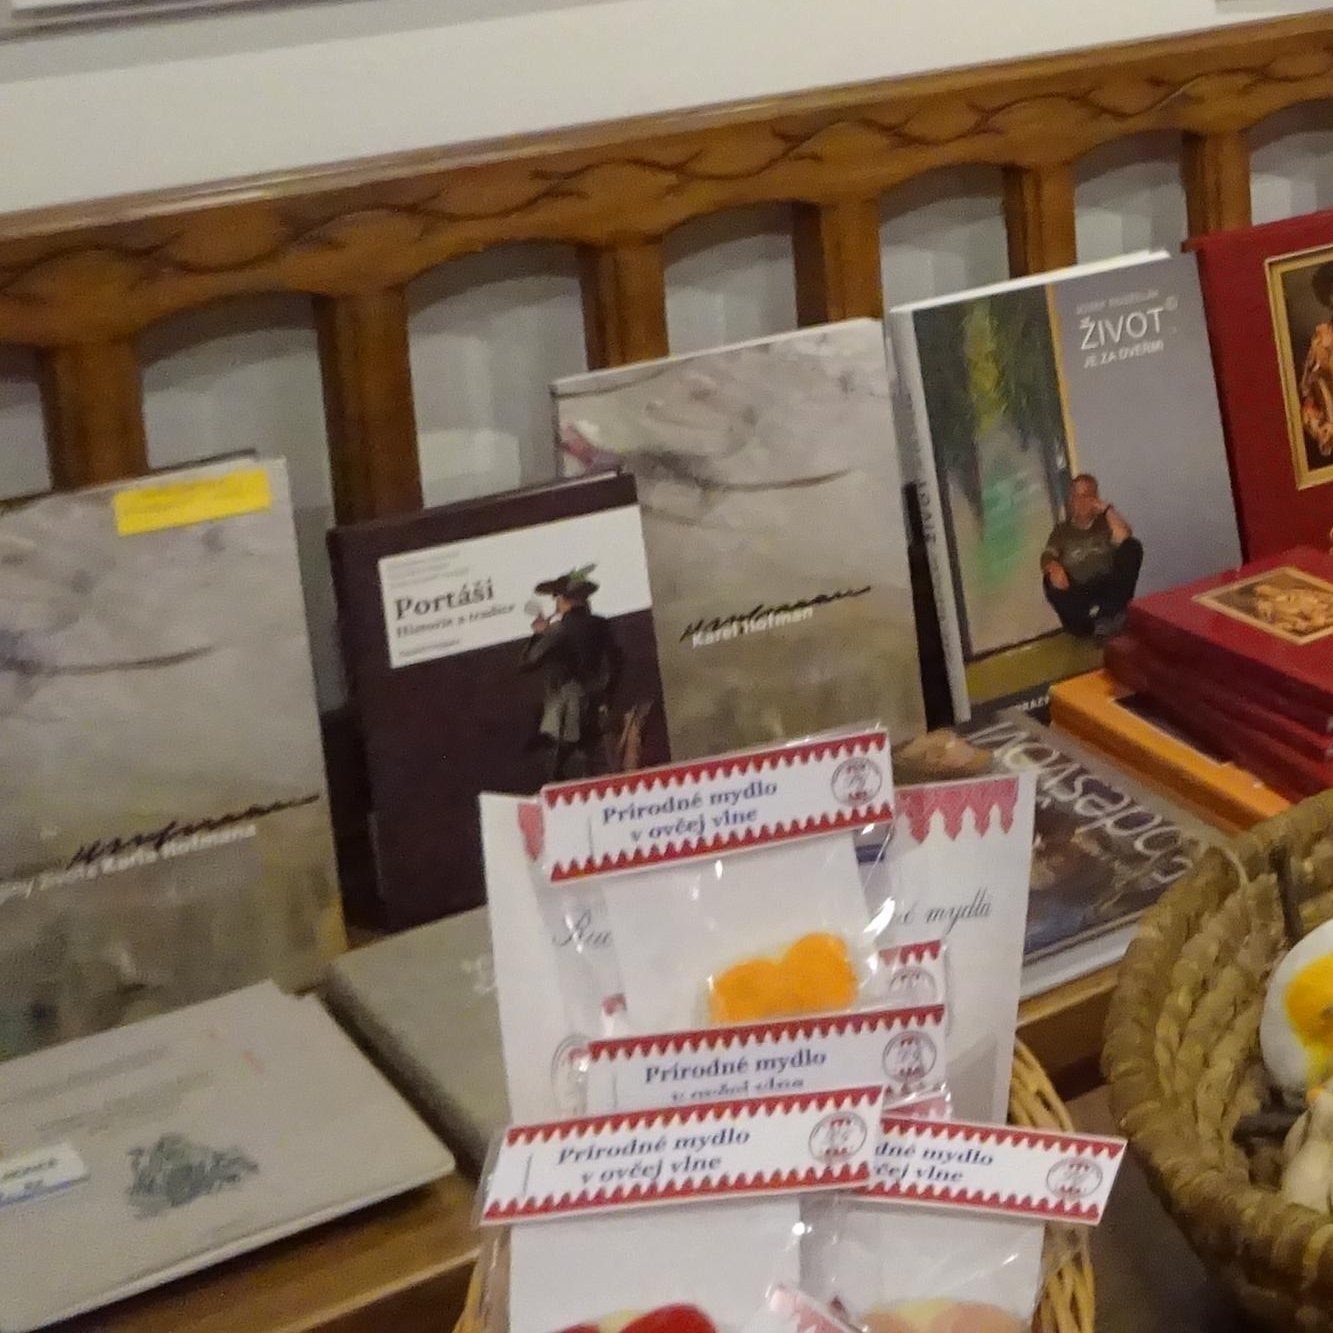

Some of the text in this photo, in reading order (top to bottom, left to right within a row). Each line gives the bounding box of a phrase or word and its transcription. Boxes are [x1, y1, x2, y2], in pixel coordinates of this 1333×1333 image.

[1080, 307, 1164, 351] ŽIVOT
[395, 577, 494, 621] Portáši
[692, 622, 739, 649] Karel
[602, 779, 778, 825] Prírodné mydlo
[630, 807, 758, 843] v ovčej vlne
[644, 1049, 827, 1085] Prírodné mydlo
[557, 1128, 751, 1166] Prírodné mydlo
[923, 1146, 994, 1166] mydlo
[580, 1153, 722, 1185] v ovčej vlne
[916, 1163, 964, 1183] vlne
